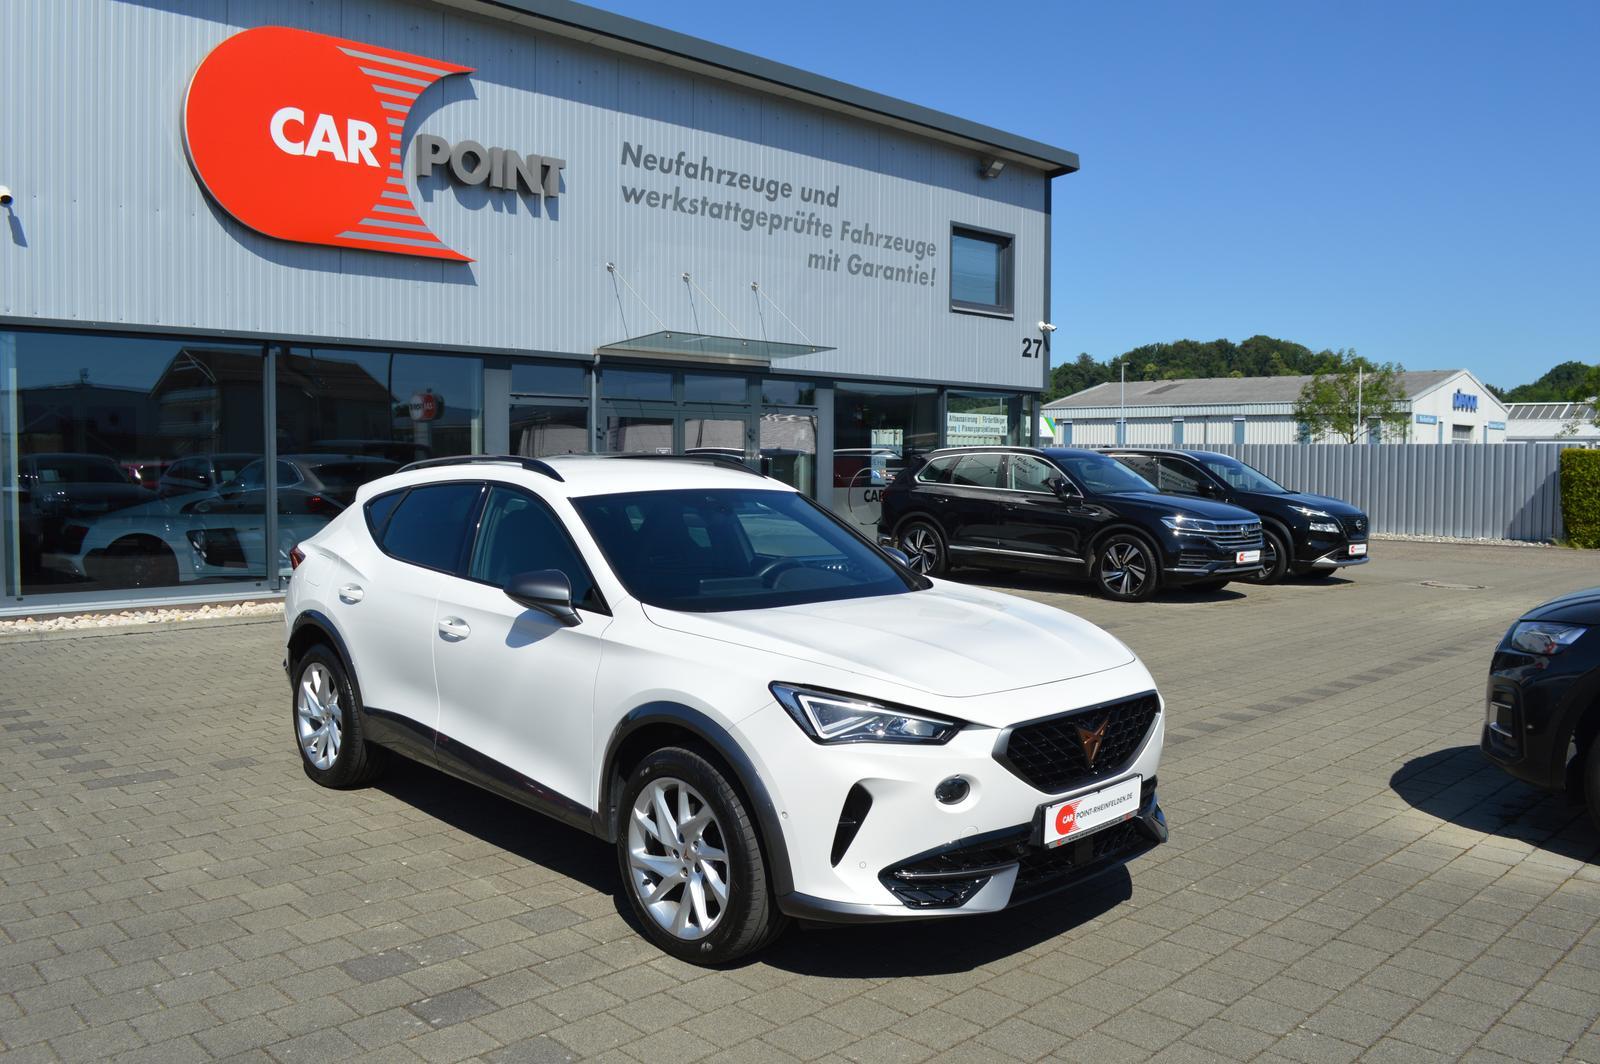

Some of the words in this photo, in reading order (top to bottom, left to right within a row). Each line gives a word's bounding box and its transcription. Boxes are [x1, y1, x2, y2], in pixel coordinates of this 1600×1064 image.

[269, 106, 381, 168] CAR
[416, 133, 567, 199] POINT
[621, 141, 793, 202] Neufahrzeuge
[800, 185, 840, 208] und
[621, 184, 833, 239] werkstattgeprüfte
[840, 220, 937, 261] Fahrzeuge
[807, 249, 841, 272] mit
[847, 253, 937, 287] Garantie!
[1022, 337, 1043, 359] 27
[1063, 812, 1074, 823] CAR
[1075, 792, 1133, 820] POINT-RHEINFELDEN.DE
